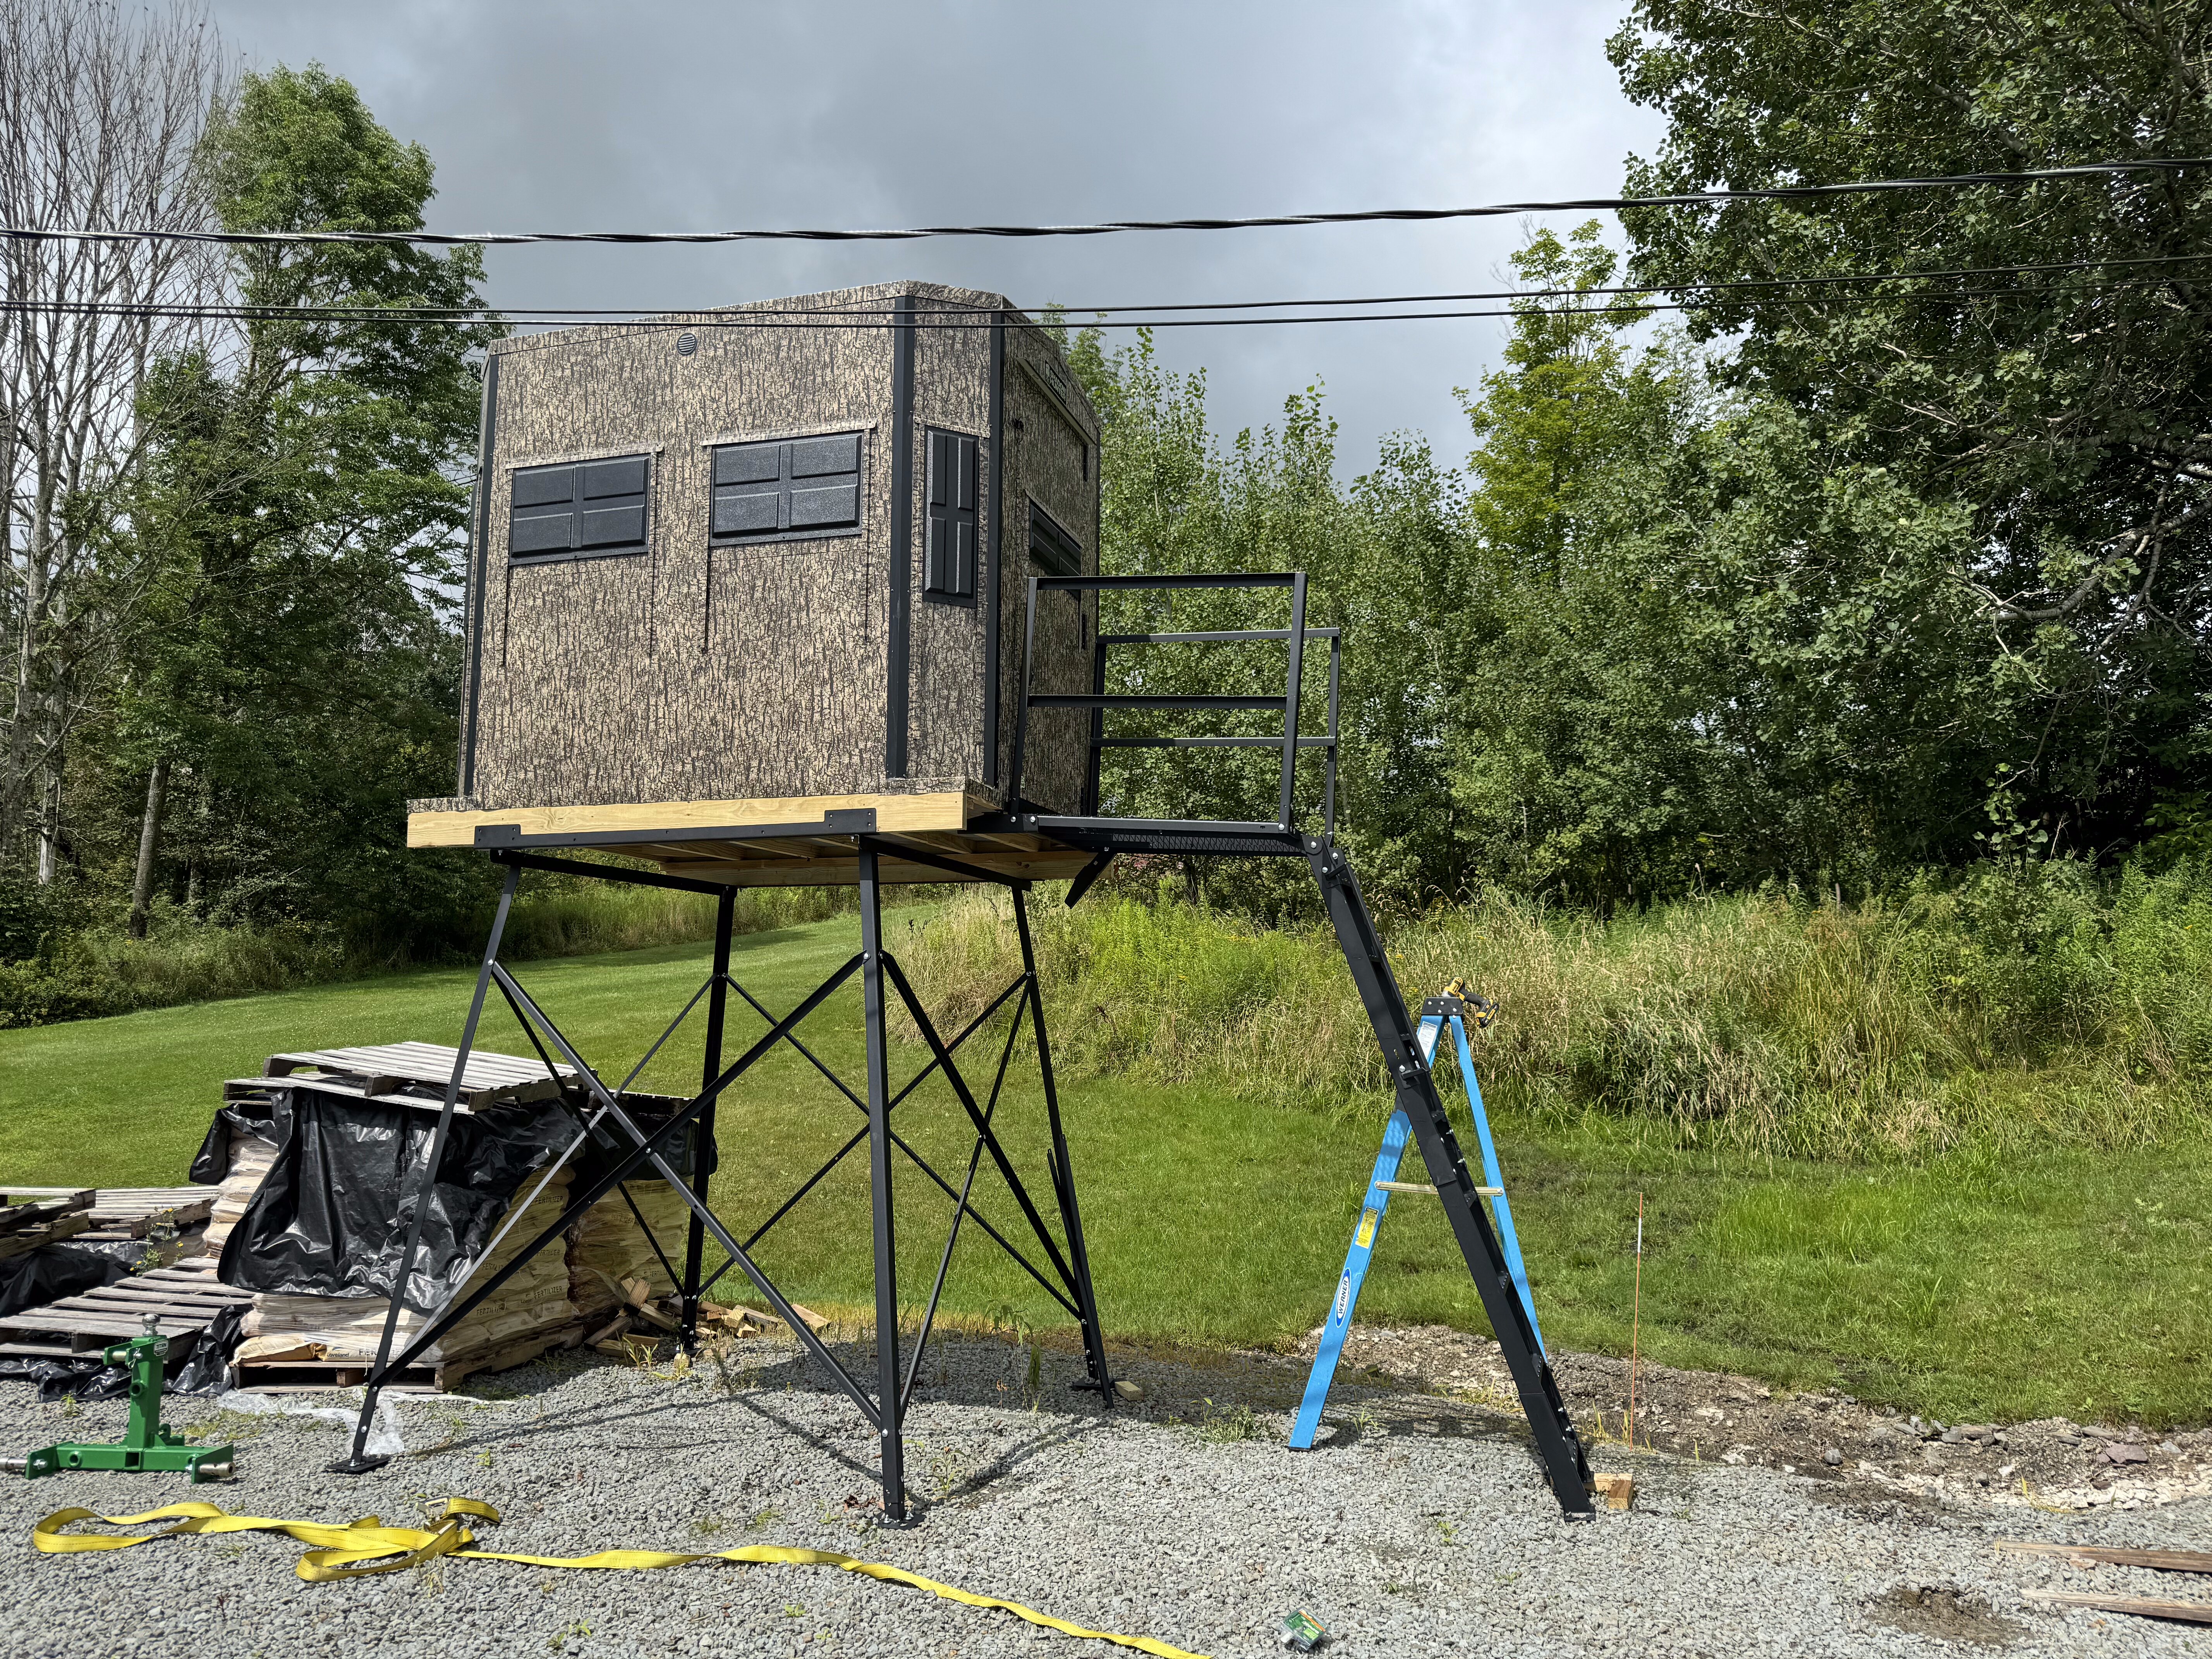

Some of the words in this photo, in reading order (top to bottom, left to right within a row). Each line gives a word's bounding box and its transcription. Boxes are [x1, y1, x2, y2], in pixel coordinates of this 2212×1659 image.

[1050, 370, 1066, 394] SHADOW
[1050, 376, 1066, 402] HUNTER
[534, 1286, 562, 1299] FERTILIZER
[1338, 1280, 1348, 1314] WERNER
